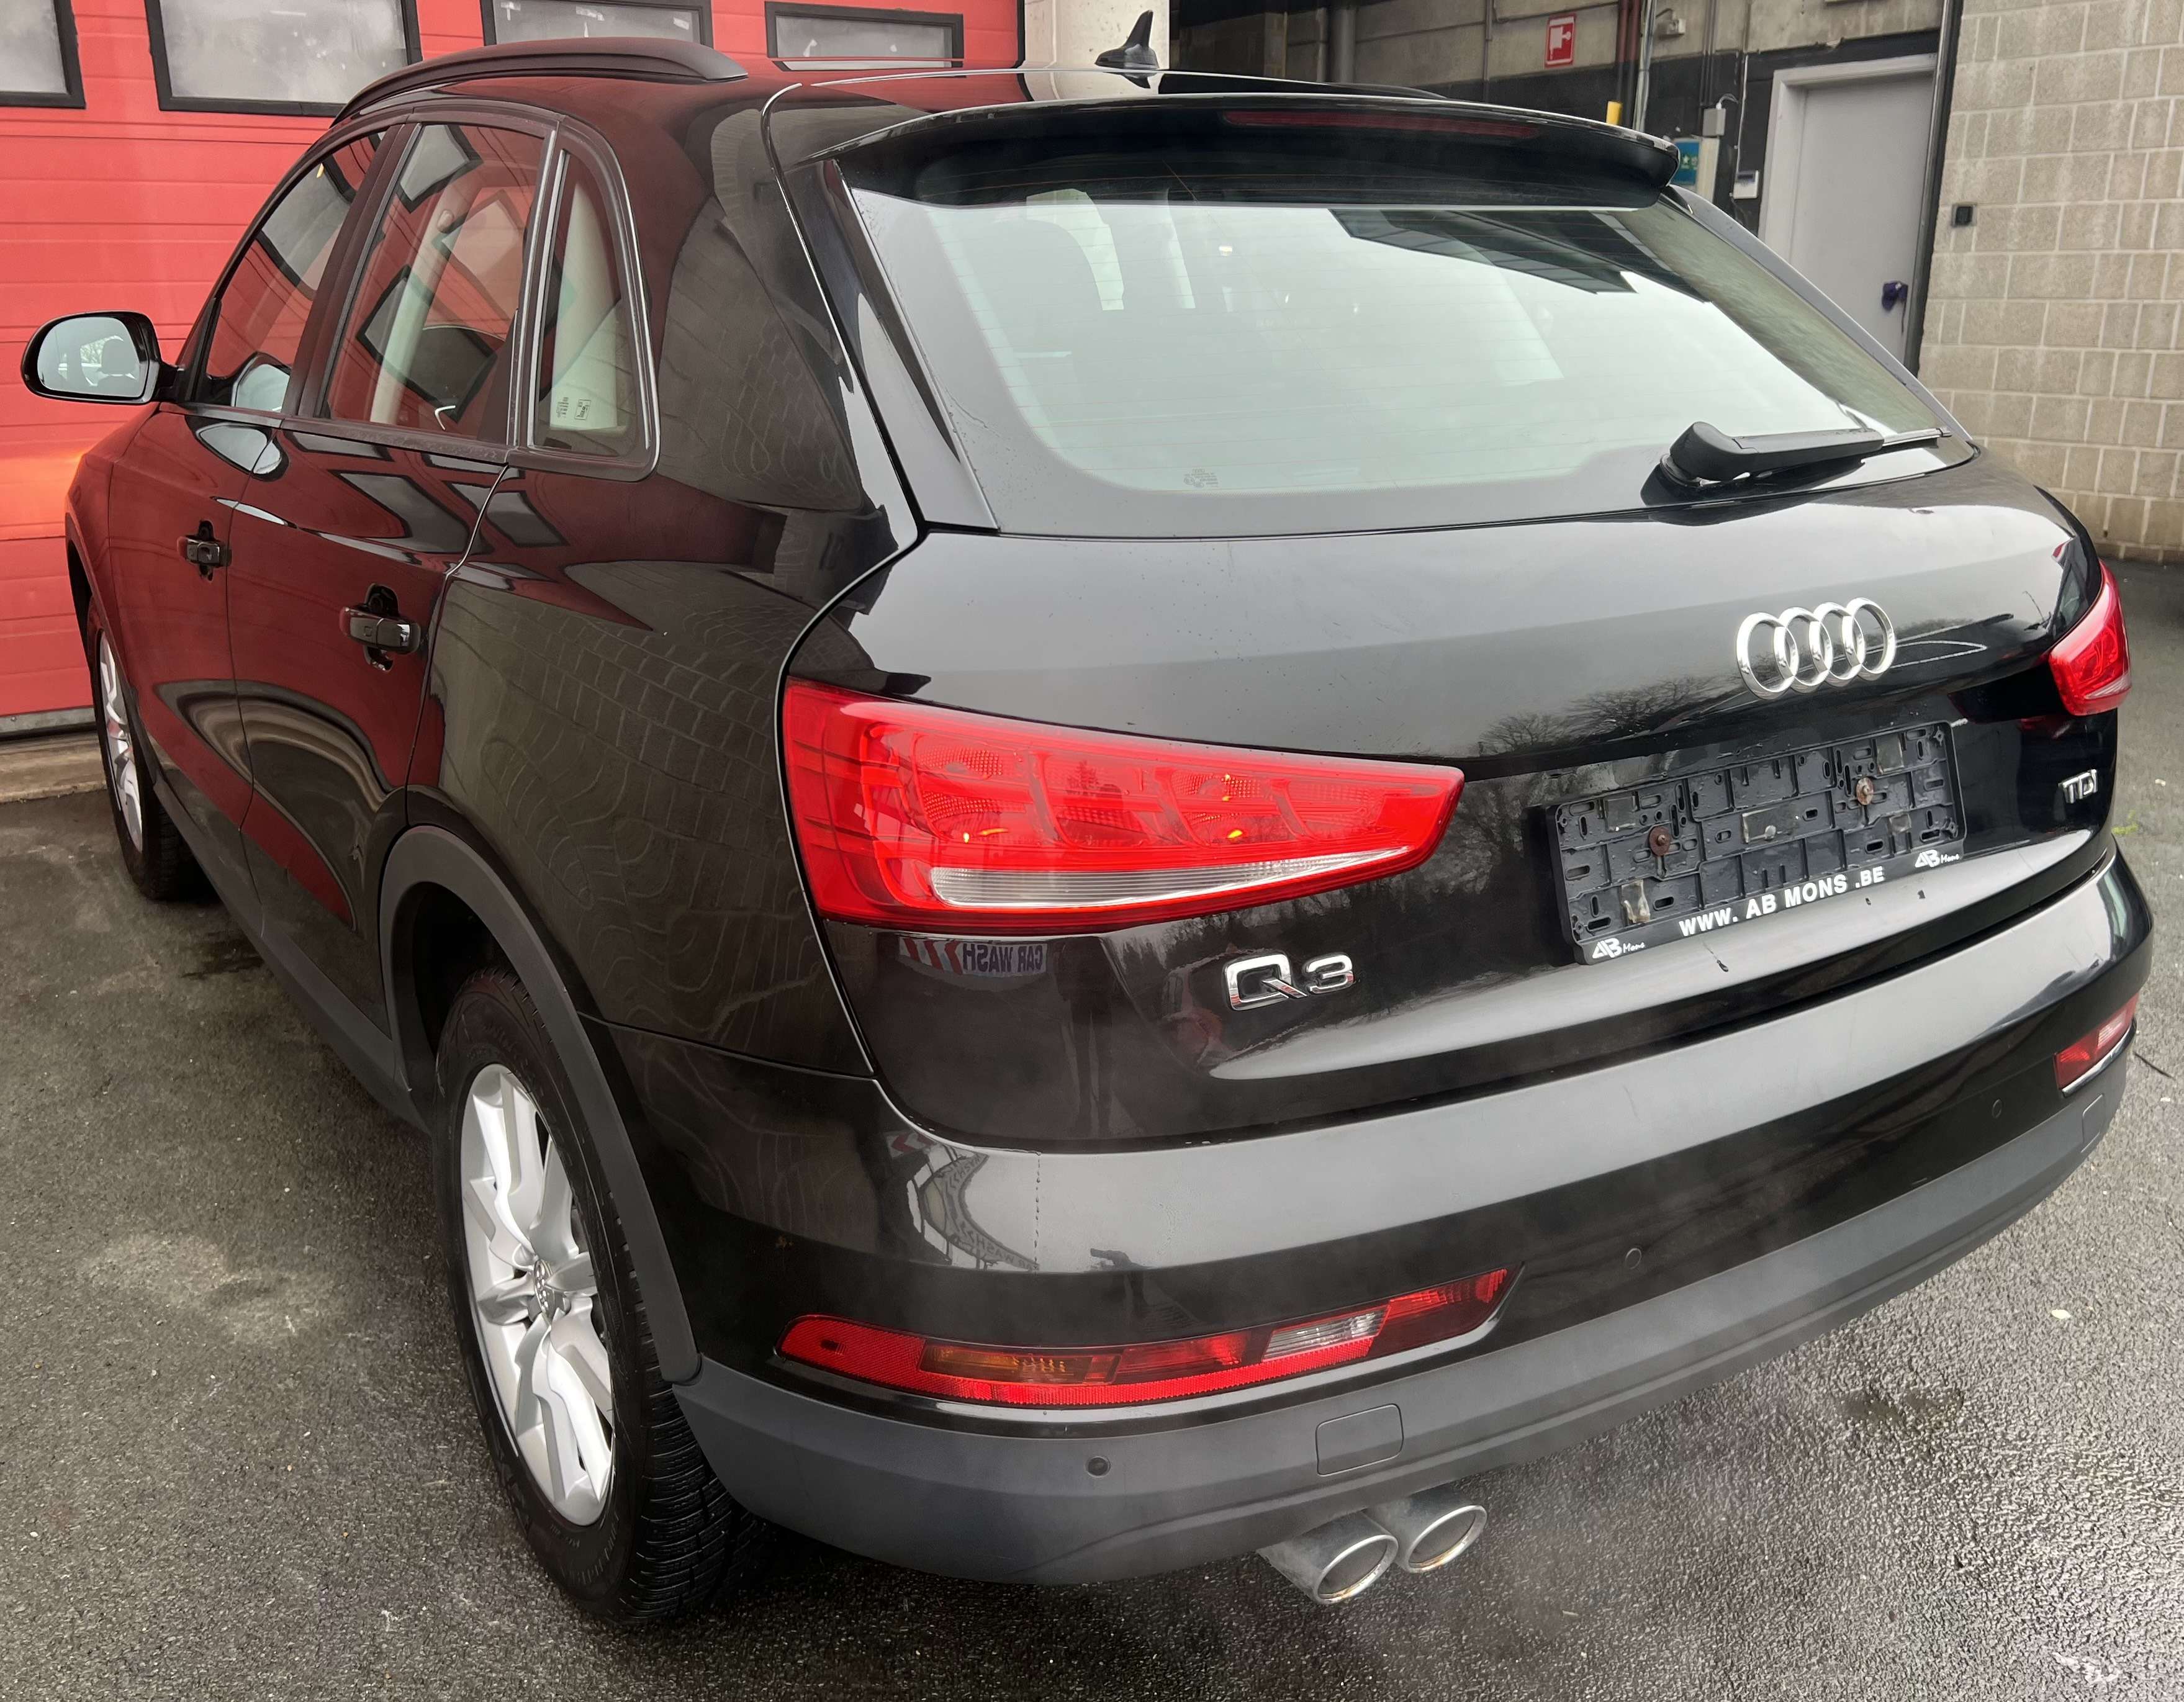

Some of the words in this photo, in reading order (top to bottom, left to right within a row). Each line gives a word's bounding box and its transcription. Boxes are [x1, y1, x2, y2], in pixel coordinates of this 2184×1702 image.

[2058, 769, 2097, 804] TDI
[1679, 907, 1738, 937] WWW.
[1746, 894, 1777, 919] AB
[1784, 874, 1848, 908] MONS
